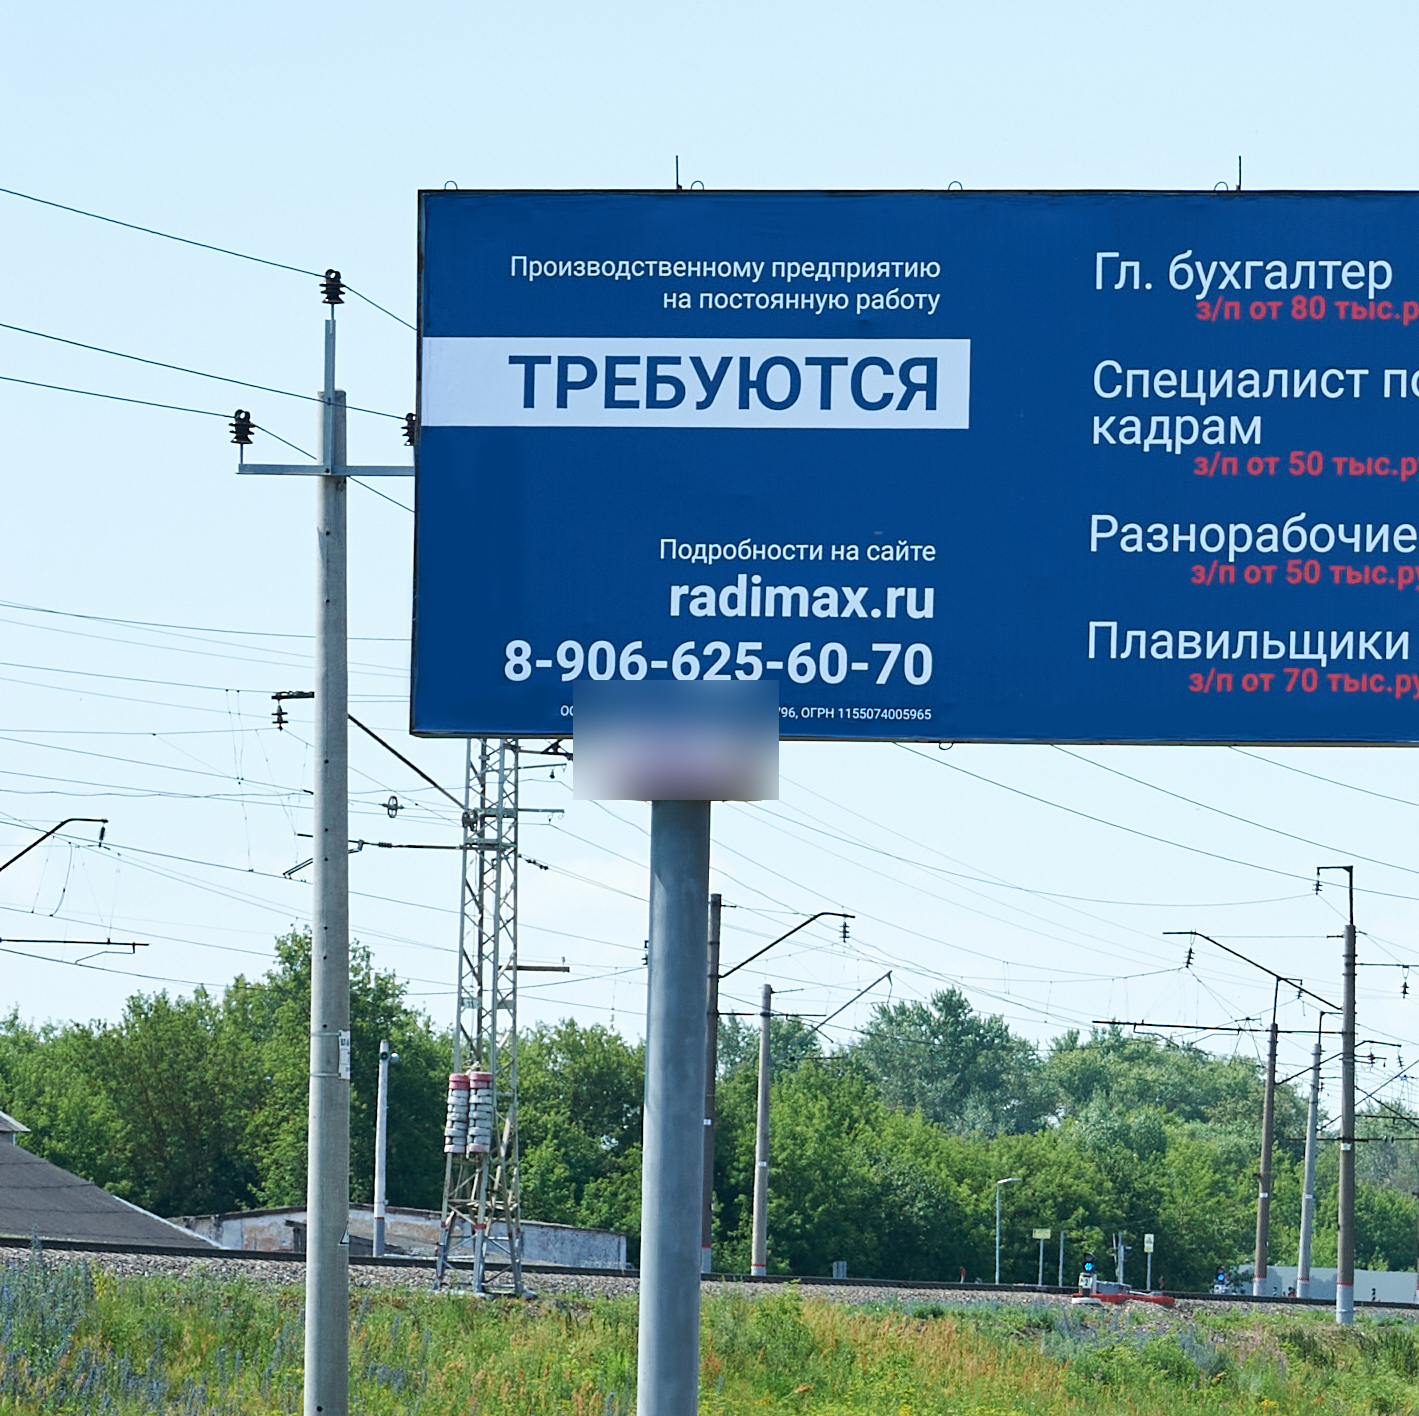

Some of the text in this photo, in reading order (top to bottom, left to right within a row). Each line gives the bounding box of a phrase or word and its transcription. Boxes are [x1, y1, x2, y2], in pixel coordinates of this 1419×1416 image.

[510, 255, 941, 283] Производственному предприятию
[1093, 249, 1393, 299] Гл. бухгалтер
[663, 287, 941, 315] на постоянную работу
[1196, 295, 1241, 322] з/п
[1249, 300, 1283, 320] от
[1290, 294, 1326, 320] 80
[507, 354, 938, 412] ТРЕБУЮТСЯ
[1093, 359, 1370, 406] Специалист
[1092, 415, 1262, 455] кадрам
[1193, 451, 1239, 478] з/п
[1246, 456, 1281, 476] от
[1288, 450, 1324, 476] 50
[660, 538, 936, 565] Подробности на сайте
[1089, 512, 1418, 563] Разнорабочие
[1190, 559, 1236, 586] з/п
[1243, 564, 1278, 585] от
[1285, 558, 1321, 585] 50
[669, 573, 936, 619] radimax.ru
[1087, 620, 1410, 668] Плавильщики
[504, 639, 934, 686] 8-906-625-60-70
[1188, 667, 1233, 694] з/п
[1241, 672, 1275, 692] от
[1283, 667, 1319, 693] 70
[800, 706, 836, 720] ОГРН
[837, 706, 933, 720] 1155074005965
